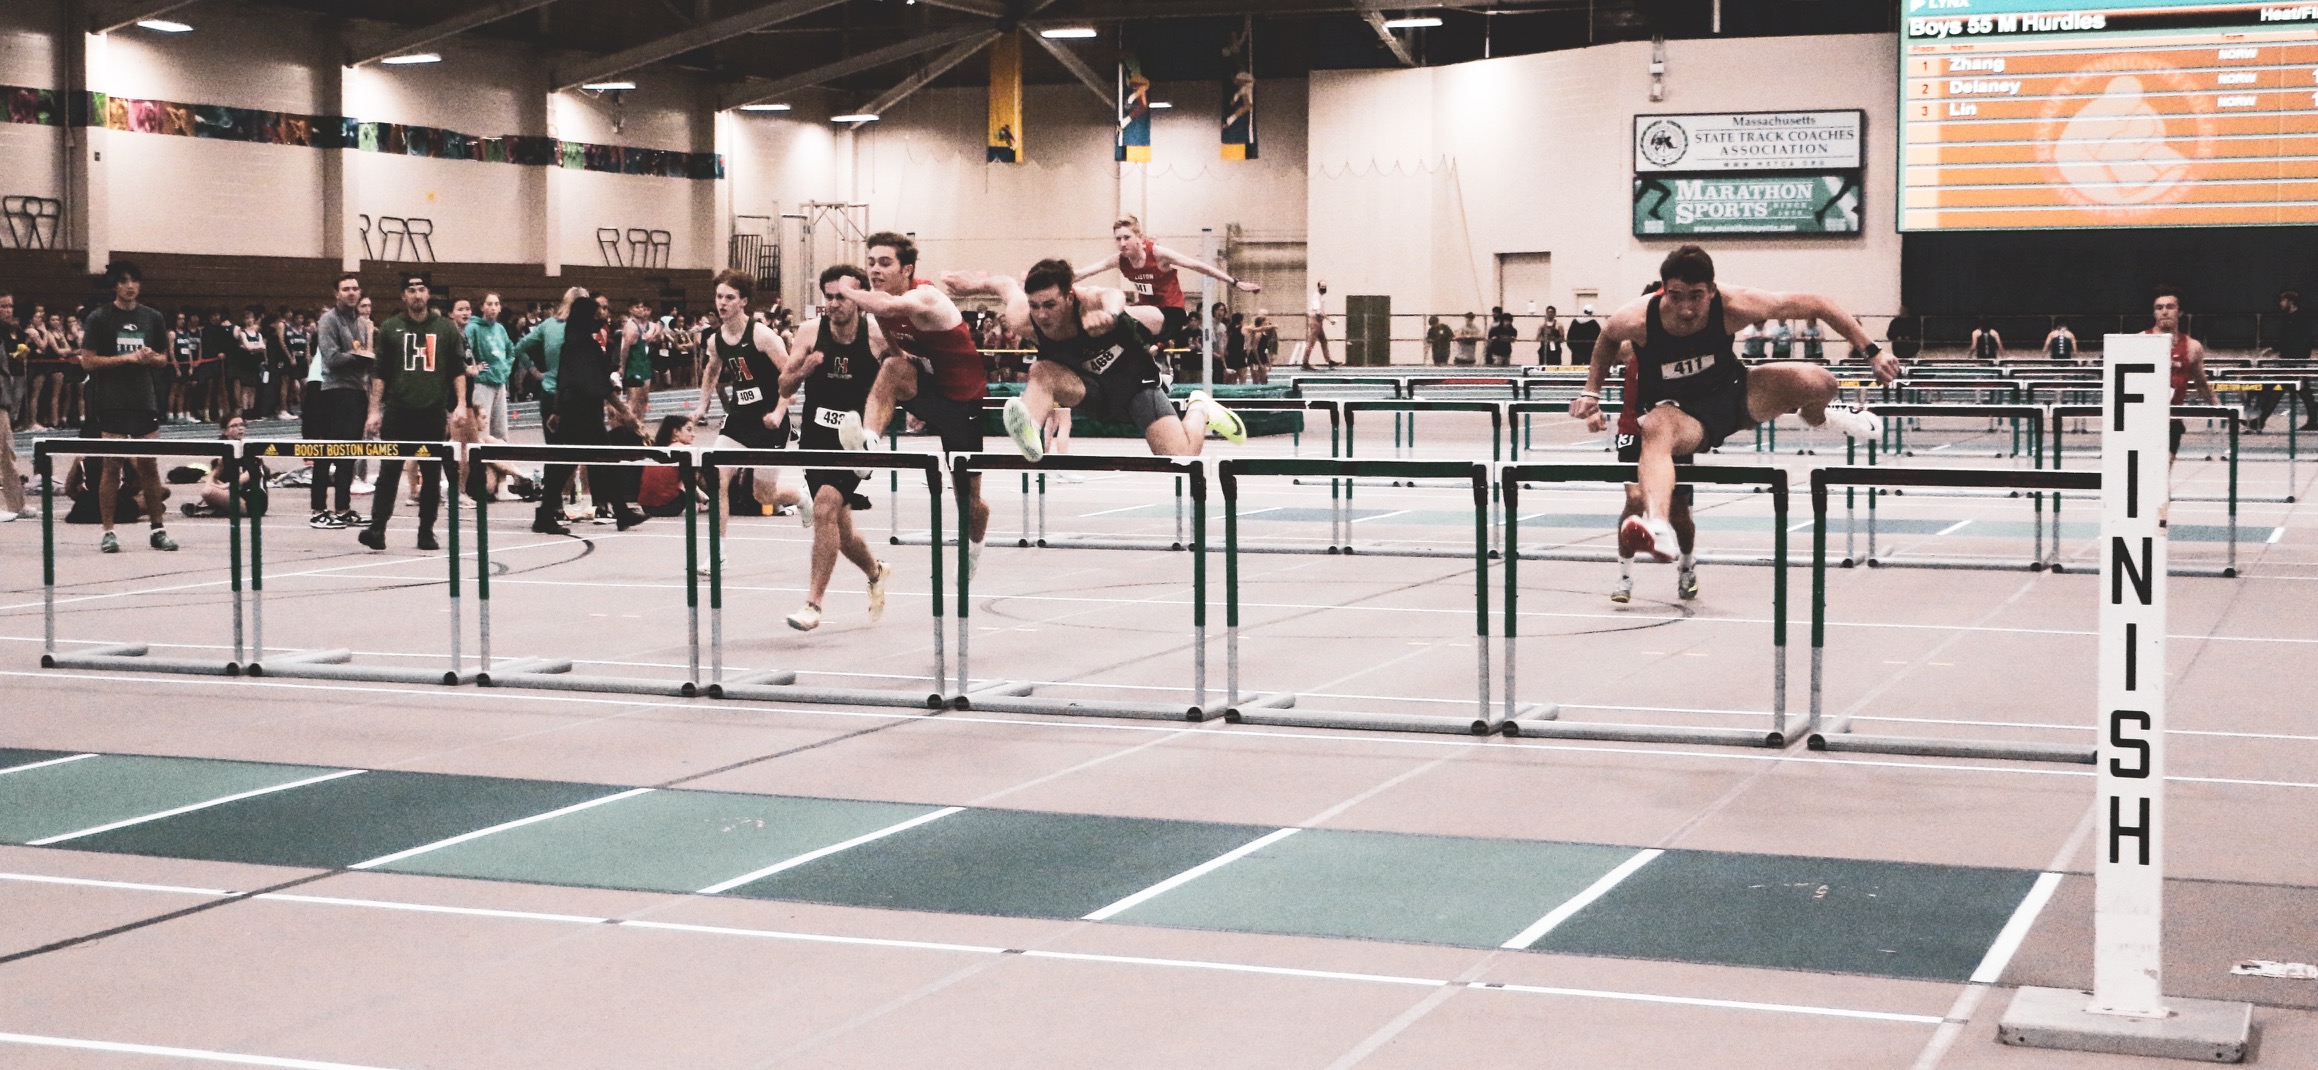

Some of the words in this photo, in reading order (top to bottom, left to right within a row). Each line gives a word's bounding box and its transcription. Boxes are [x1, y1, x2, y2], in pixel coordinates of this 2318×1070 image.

[1909, 17, 1962, 39] Boys
[1967, 17, 1994, 34] 55
[1997, 15, 2018, 33] M
[2021, 12, 2106, 32] Hurdles
[1923, 61, 1928, 71] 1
[1949, 58, 2006, 73] Zhang
[1922, 84, 1929, 94] 2
[1949, 79, 2022, 95] Delaney
[1922, 106, 1928, 116] 3
[1949, 102, 1977, 116] Lin
[1732, 115, 1816, 127] Massachusetts
[1695, 133, 1734, 144] STATE
[1740, 131, 1784, 142] TRACK
[1788, 129, 1855, 141] COACHES
[1720, 144, 1828, 156] ASSOCIATION
[1675, 180, 1813, 201] MARATHON
[1675, 202, 1768, 224] SPORTS
[404, 333, 437, 371] H
[1090, 350, 1115, 372] 468
[1673, 357, 1702, 375] 411
[294, 444, 324, 457] BOOST
[326, 444, 365, 457] BOSTON
[365, 444, 399, 457] GAMES
[2109, 362, 2156, 867] FINISH
